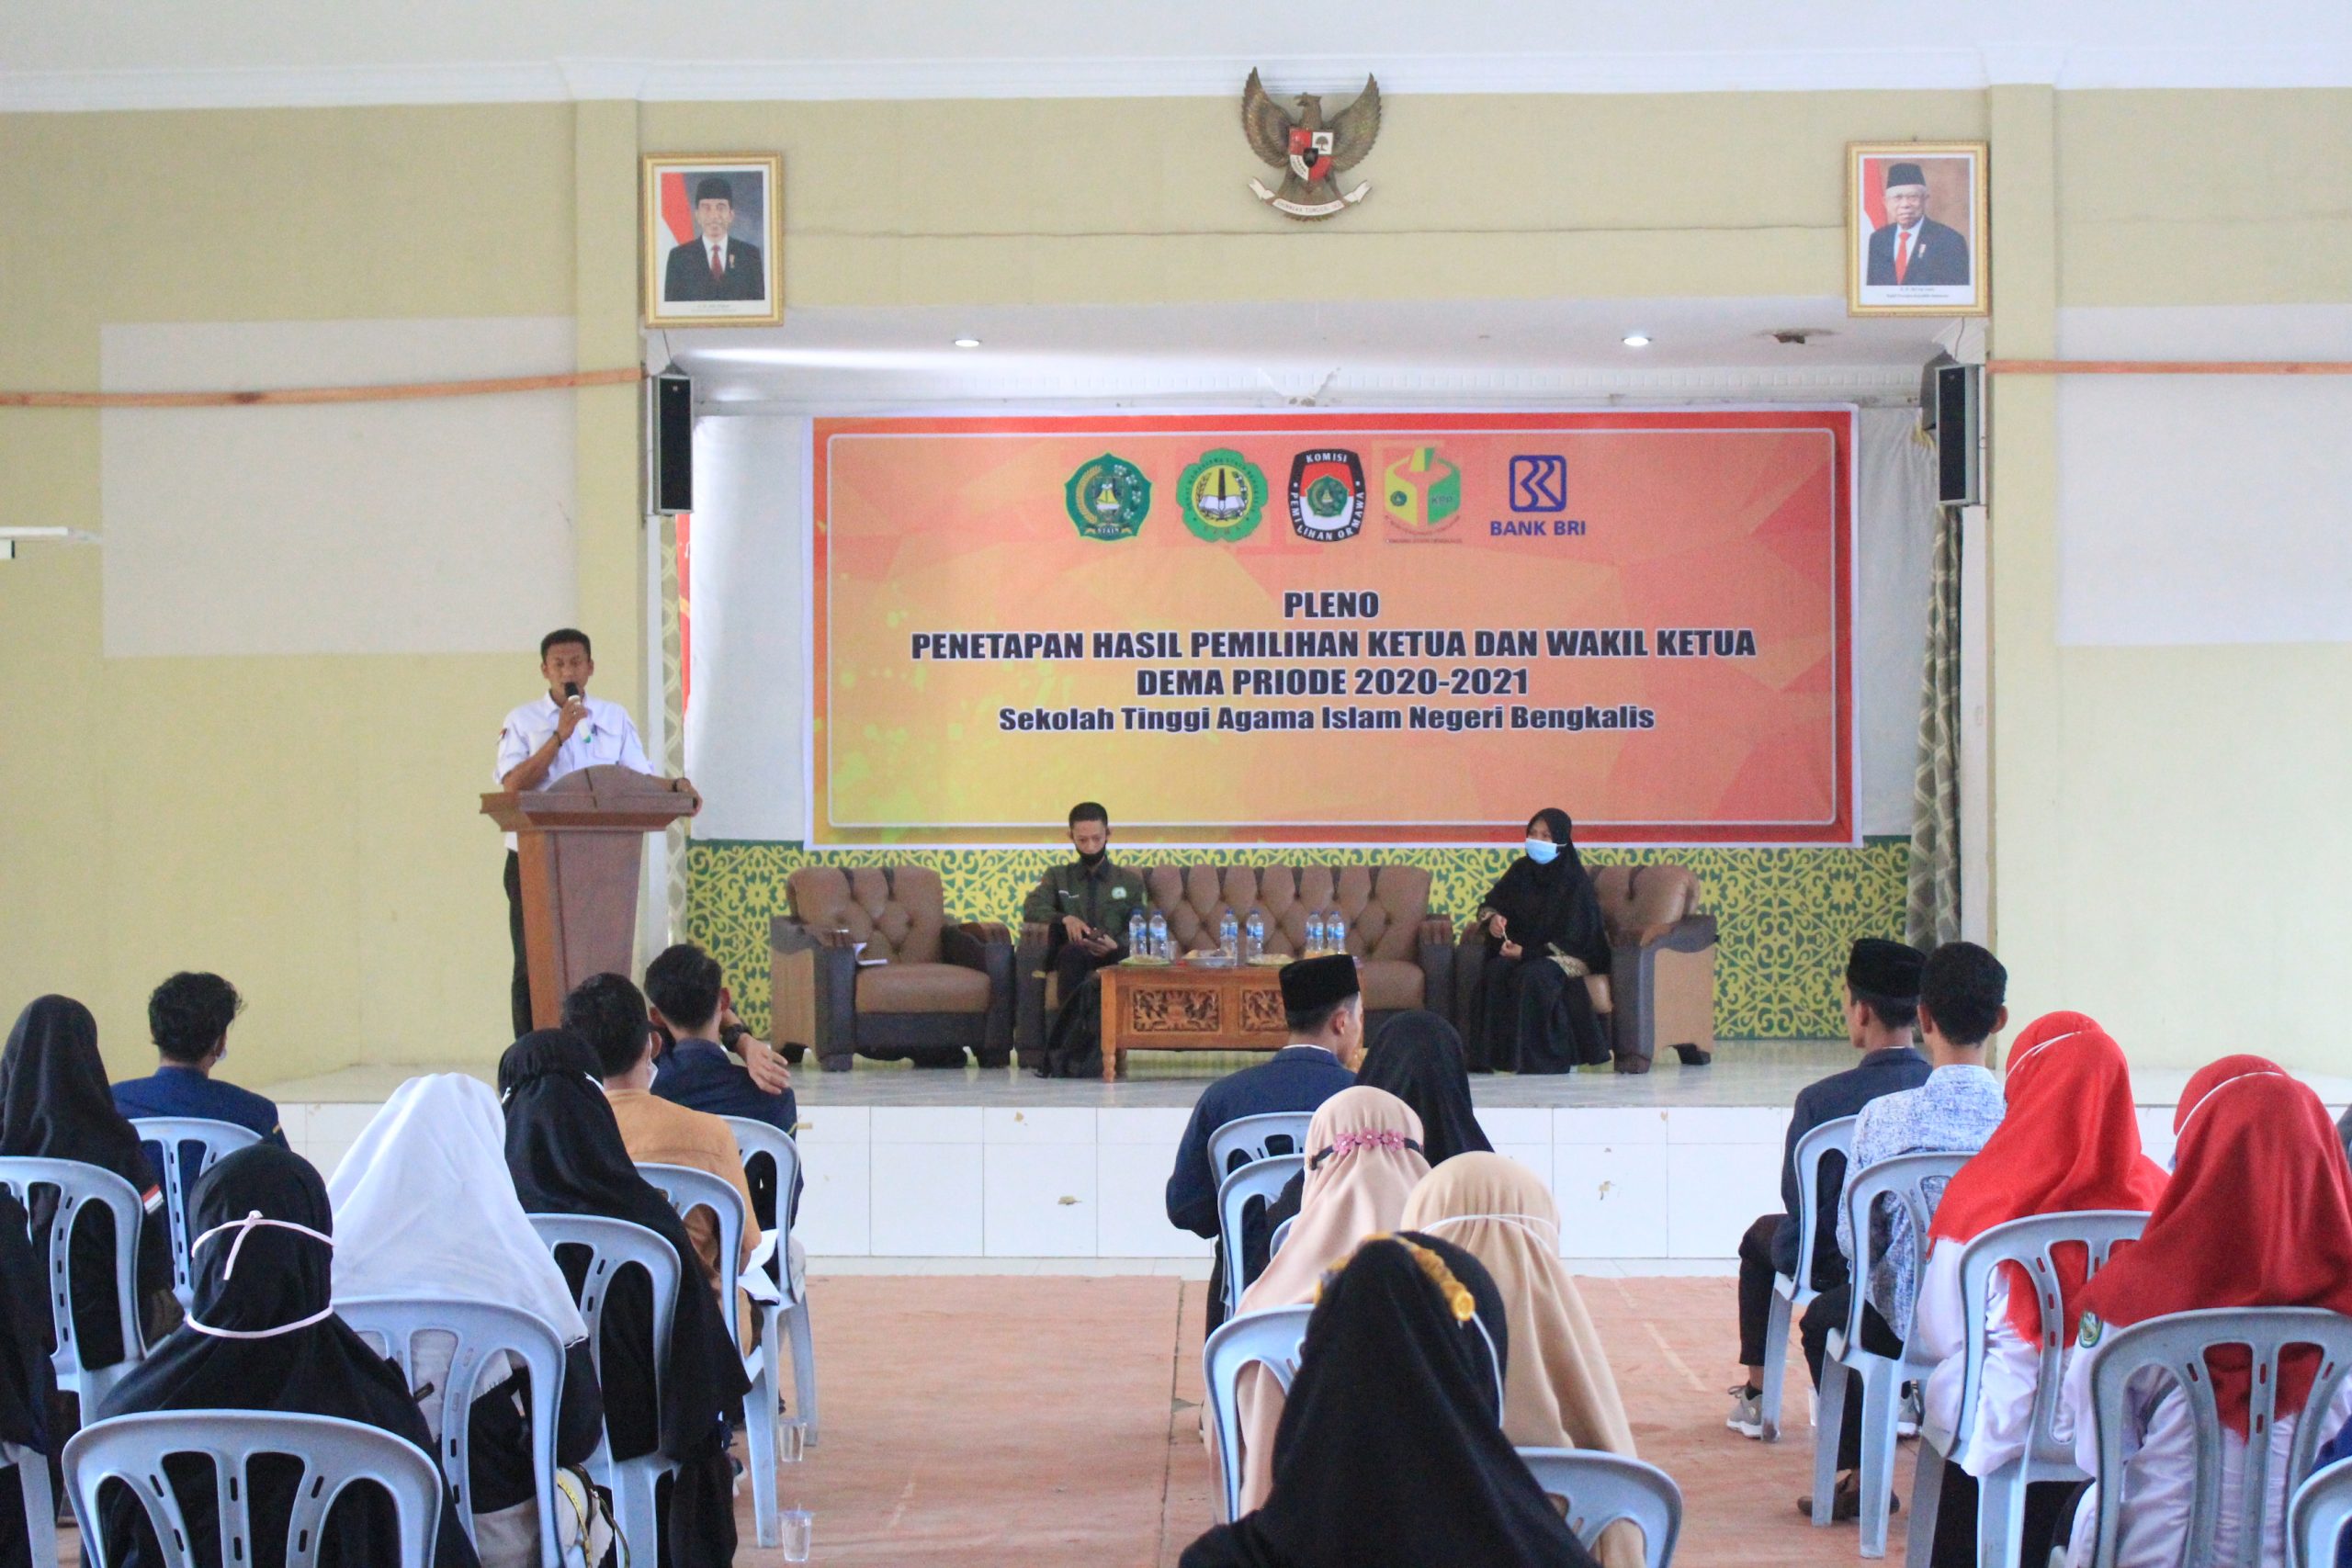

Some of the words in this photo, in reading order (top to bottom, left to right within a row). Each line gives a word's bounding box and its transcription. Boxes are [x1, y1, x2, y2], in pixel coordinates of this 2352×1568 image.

[1306, 452, 1348, 463] KOMISI
[1290, 491, 1333, 541] PEMILIHAN
[1489, 520, 1547, 536] BANK
[1553, 520, 1587, 536] BRI
[1284, 592, 1379, 618] PLENO
[912, 633, 1083, 660] PENETAPAN
[1093, 632, 1182, 659] HASIL
[1191, 631, 1358, 658] PEMILIHAN
[1368, 631, 1466, 657] KETUA
[1475, 630, 1537, 657] DAN
[1545, 630, 1648, 657] WAKIL
[1657, 629, 1757, 657] KETUA
[1137, 670, 1225, 695] DEMA
[1233, 669, 1346, 695] PRIODE
[1355, 668, 1527, 695] 2020-2021
[1000, 708, 1114, 730] Sekolah
[1121, 707, 1210, 733] Tinggi
[1216, 707, 1314, 732] Agama
[1322, 706, 1401, 729] Islam
[1409, 706, 1503, 732] Negeri
[1511, 705, 1655, 731] Bengkalis
